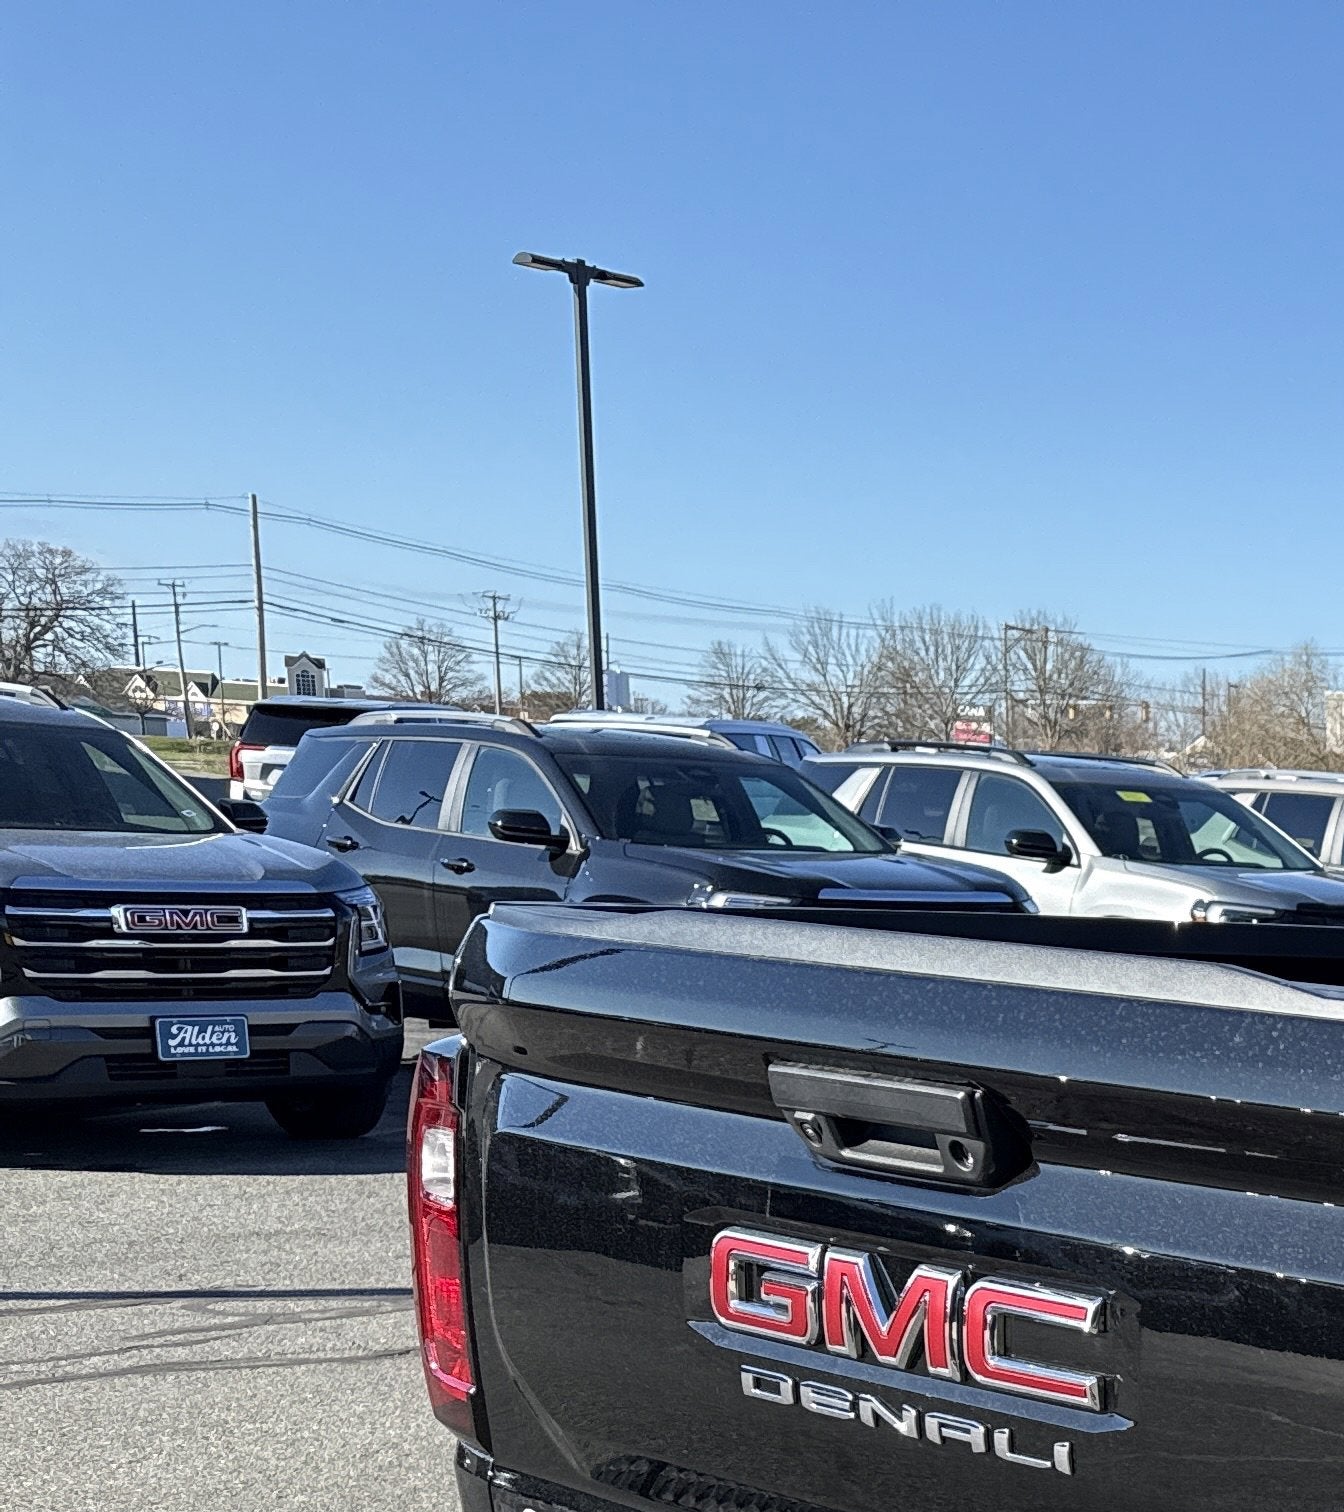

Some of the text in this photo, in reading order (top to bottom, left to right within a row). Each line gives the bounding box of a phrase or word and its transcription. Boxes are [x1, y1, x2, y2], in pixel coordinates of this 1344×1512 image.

[126, 909, 243, 930] GMC
[167, 1024, 239, 1046] Alden
[213, 1024, 235, 1032] AUTO
[170, 1046, 195, 1054] LOVE
[709, 1226, 1116, 1412] GMC
[740, 1364, 1074, 1475] DENALI
